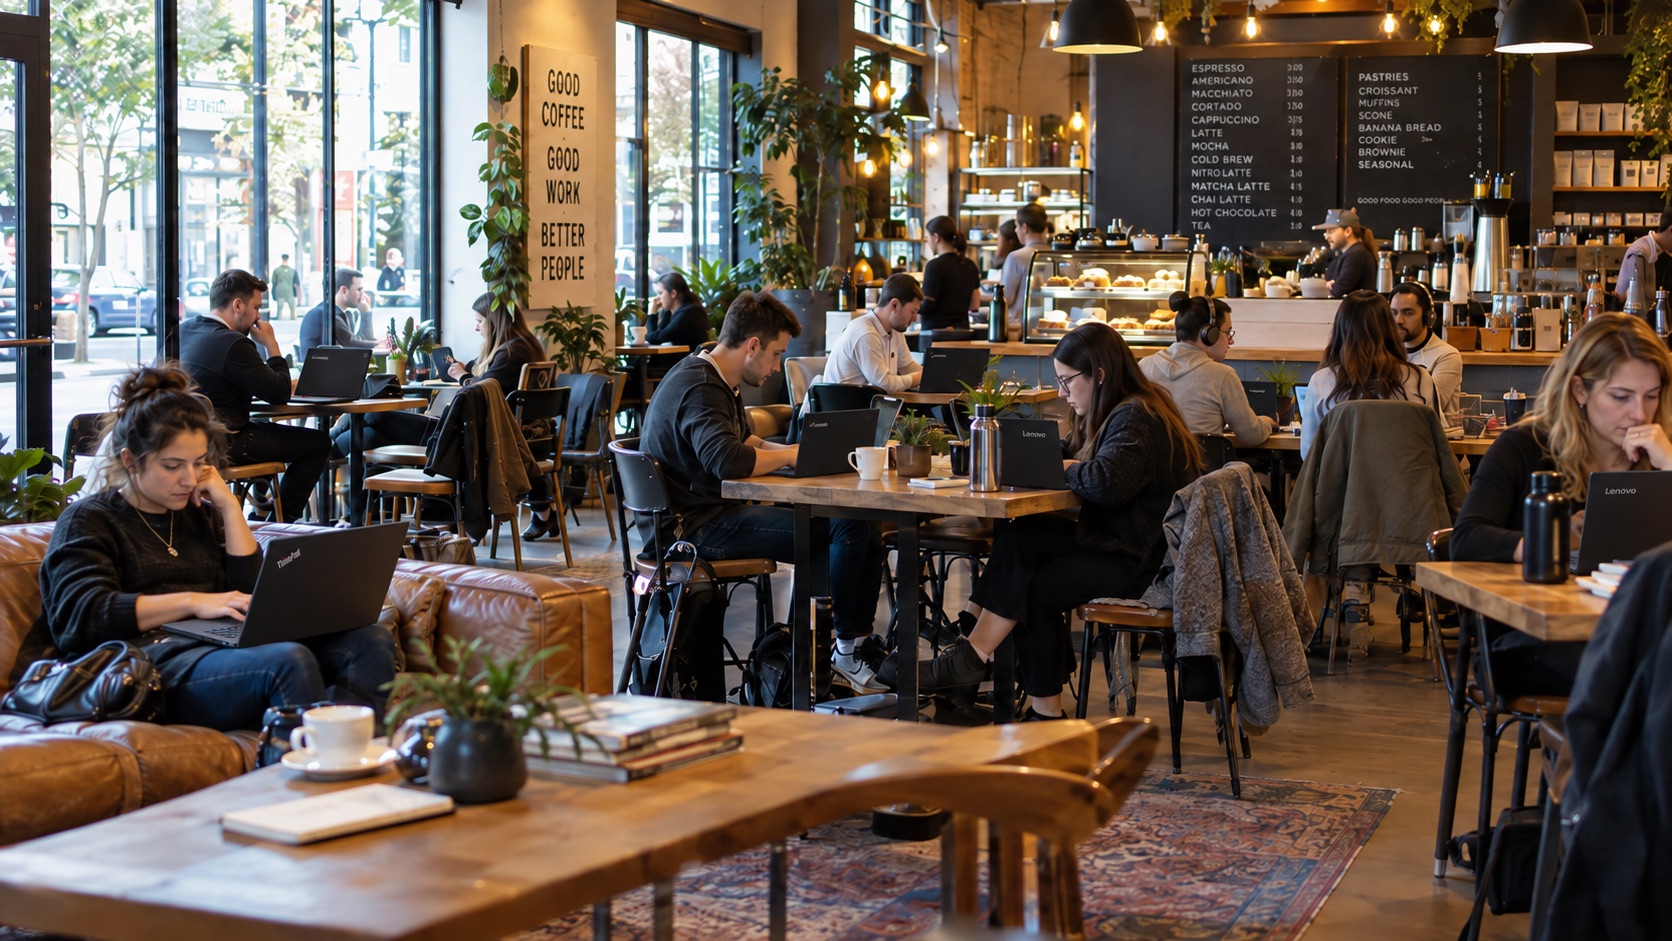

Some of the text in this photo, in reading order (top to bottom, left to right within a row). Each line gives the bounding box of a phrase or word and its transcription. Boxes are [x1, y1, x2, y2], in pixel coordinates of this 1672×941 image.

[1191, 64, 1245, 73] ESPRESSO
[1191, 76, 1254, 85] AMERICANO
[1358, 72, 1409, 82] PASTRIES
[547, 69, 580, 97] GOOD
[1191, 89, 1254, 98] MACCHIATO
[1358, 86, 1419, 96] CROISSANT
[1191, 102, 1242, 111] CORTADO
[1358, 99, 1400, 107] MUFFINS
[541, 101, 585, 130] COFFEE
[1358, 111, 1393, 120] SCONE
[1191, 116, 1260, 125] CAPPUCCINO
[1358, 123, 1442, 132] BANANA BREAD
[1191, 129, 1223, 138] LATTE
[1358, 136, 1397, 144] COOKIE
[1191, 142, 1229, 151] MOCHA
[1358, 148, 1406, 156] BROWNIE
[547, 146, 580, 172] GOOD
[1191, 155, 1254, 164] COLD BREW
[1358, 160, 1414, 169] SEASONAL
[1191, 169, 1252, 177] NITRO LATTE
[1191, 182, 1271, 191] MATCHA LATTE
[545, 179, 581, 205] WORK
[1191, 195, 1252, 204] CHAI LATTE
[1191, 208, 1277, 217] HOT CHOCOLATE
[1191, 221, 1212, 230] TEA
[541, 222, 585, 247] BETTER
[541, 256, 585, 281] PEOPLE
[1604, 487, 1637, 495] Lenovo
